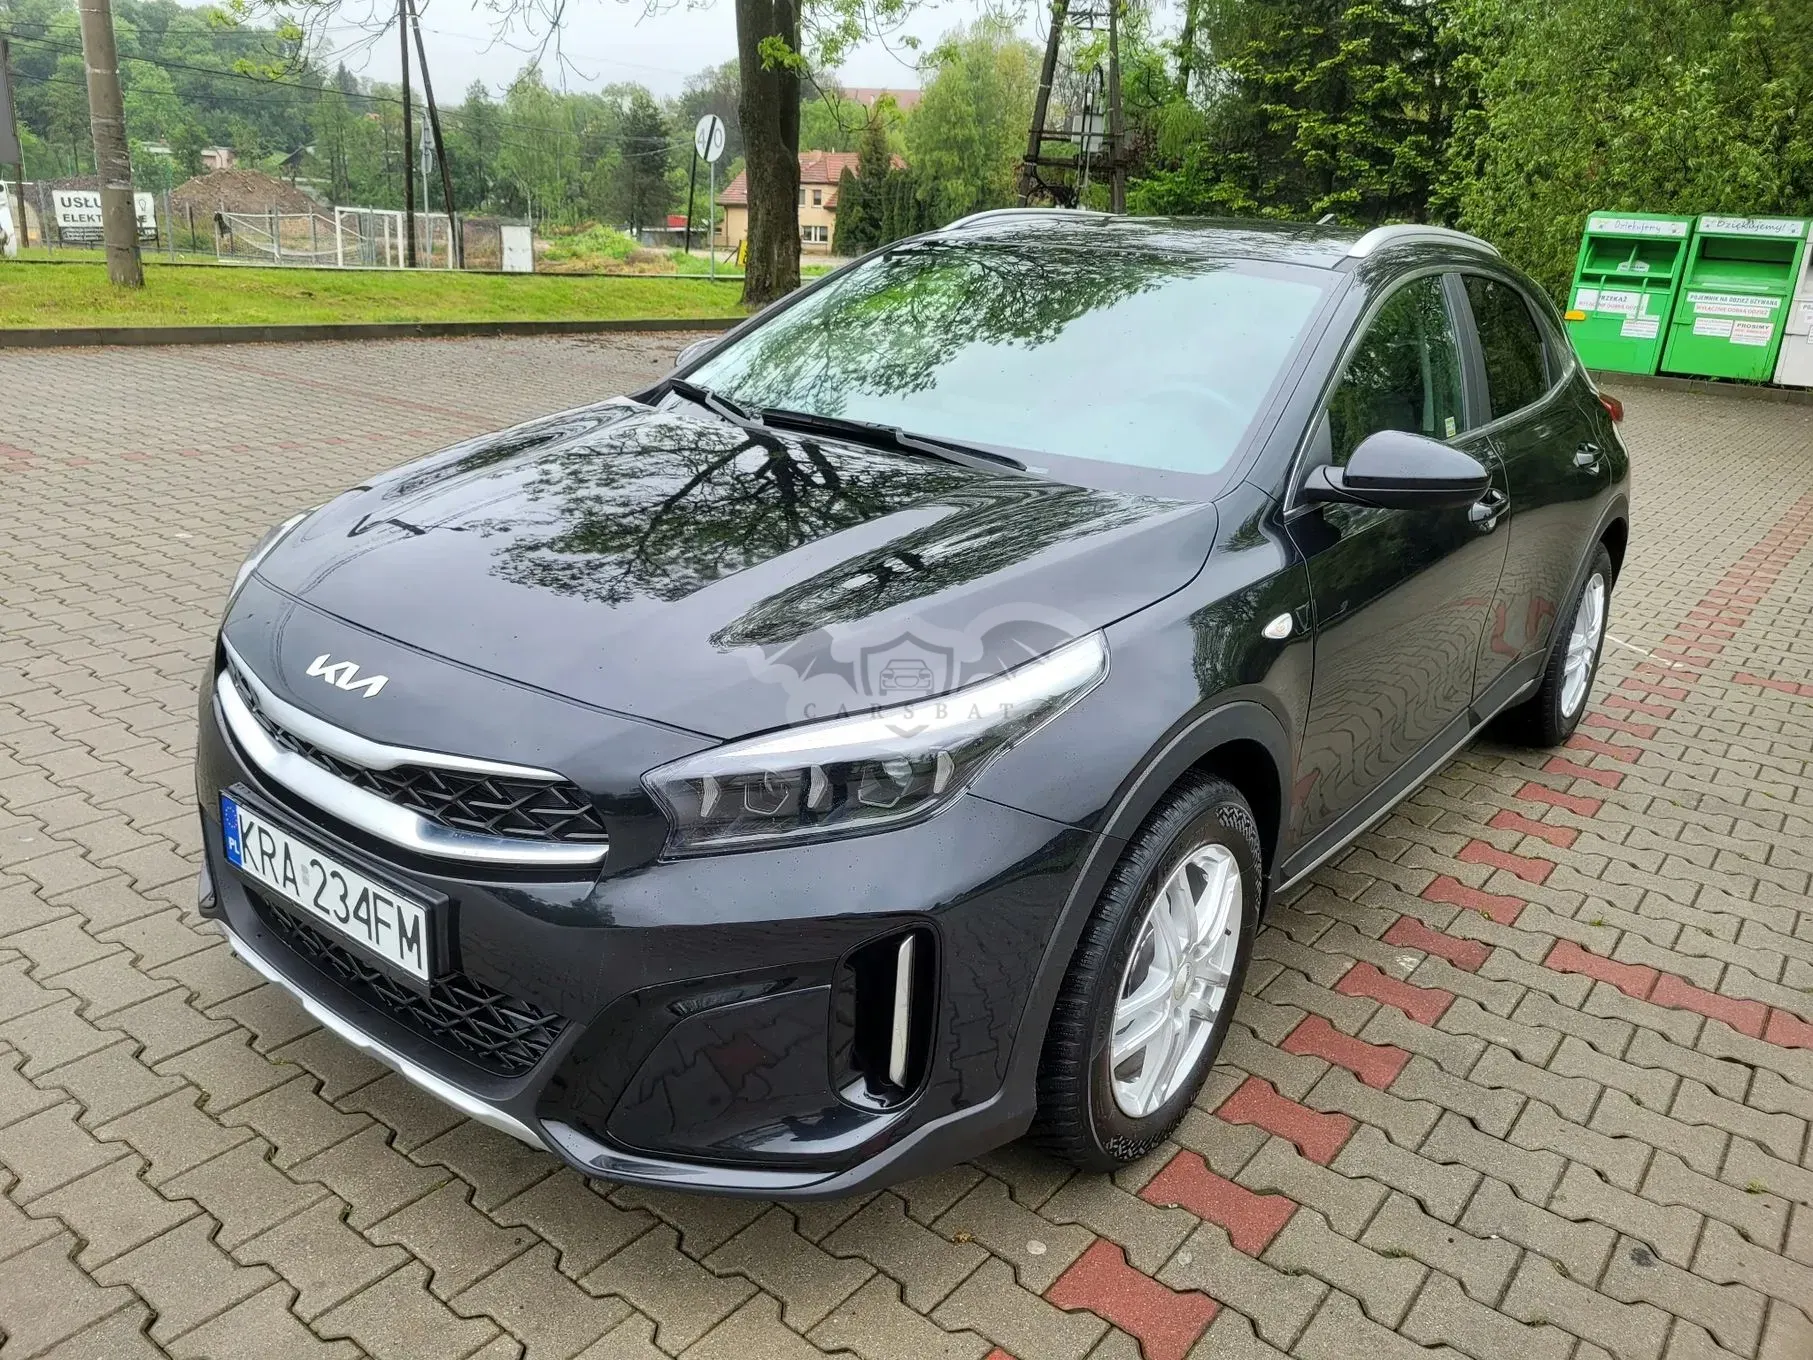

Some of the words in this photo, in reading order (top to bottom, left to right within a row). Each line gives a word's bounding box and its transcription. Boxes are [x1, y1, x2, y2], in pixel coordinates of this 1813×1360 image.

[698, 128, 723, 149] 40
[1598, 295, 1628, 303] RZEKAŻ
[228, 836, 240, 855] PL
[238, 814, 300, 898] KRA
[310, 858, 424, 971] 234FM
